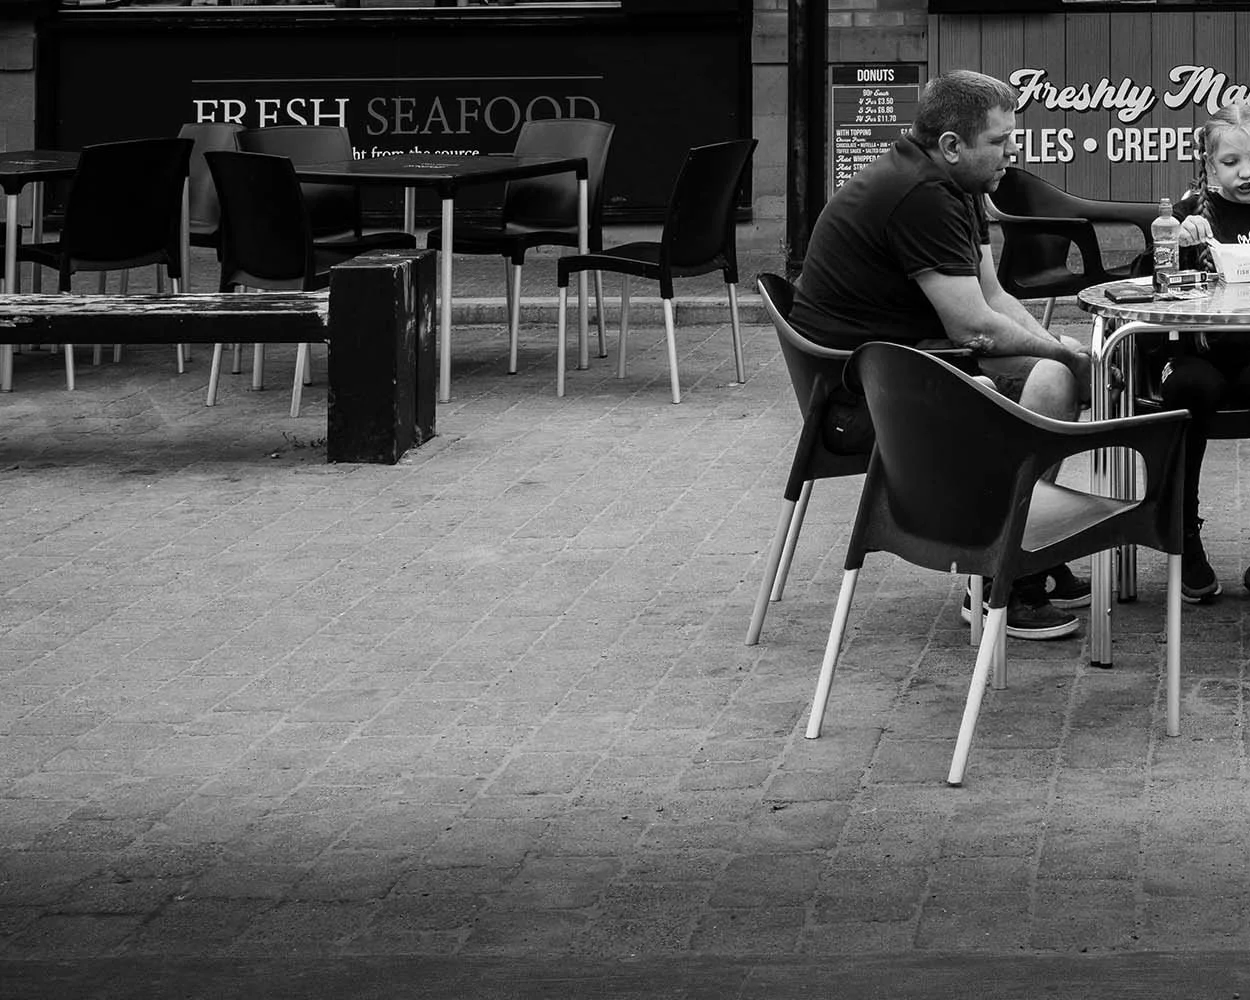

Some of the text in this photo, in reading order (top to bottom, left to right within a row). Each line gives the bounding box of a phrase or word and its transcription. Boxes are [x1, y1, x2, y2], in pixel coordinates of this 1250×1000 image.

[857, 69, 895, 82] DONUTS
[1009, 68, 1155, 123] Freshly
[192, 95, 600, 136] FRESH SEAFOOD
